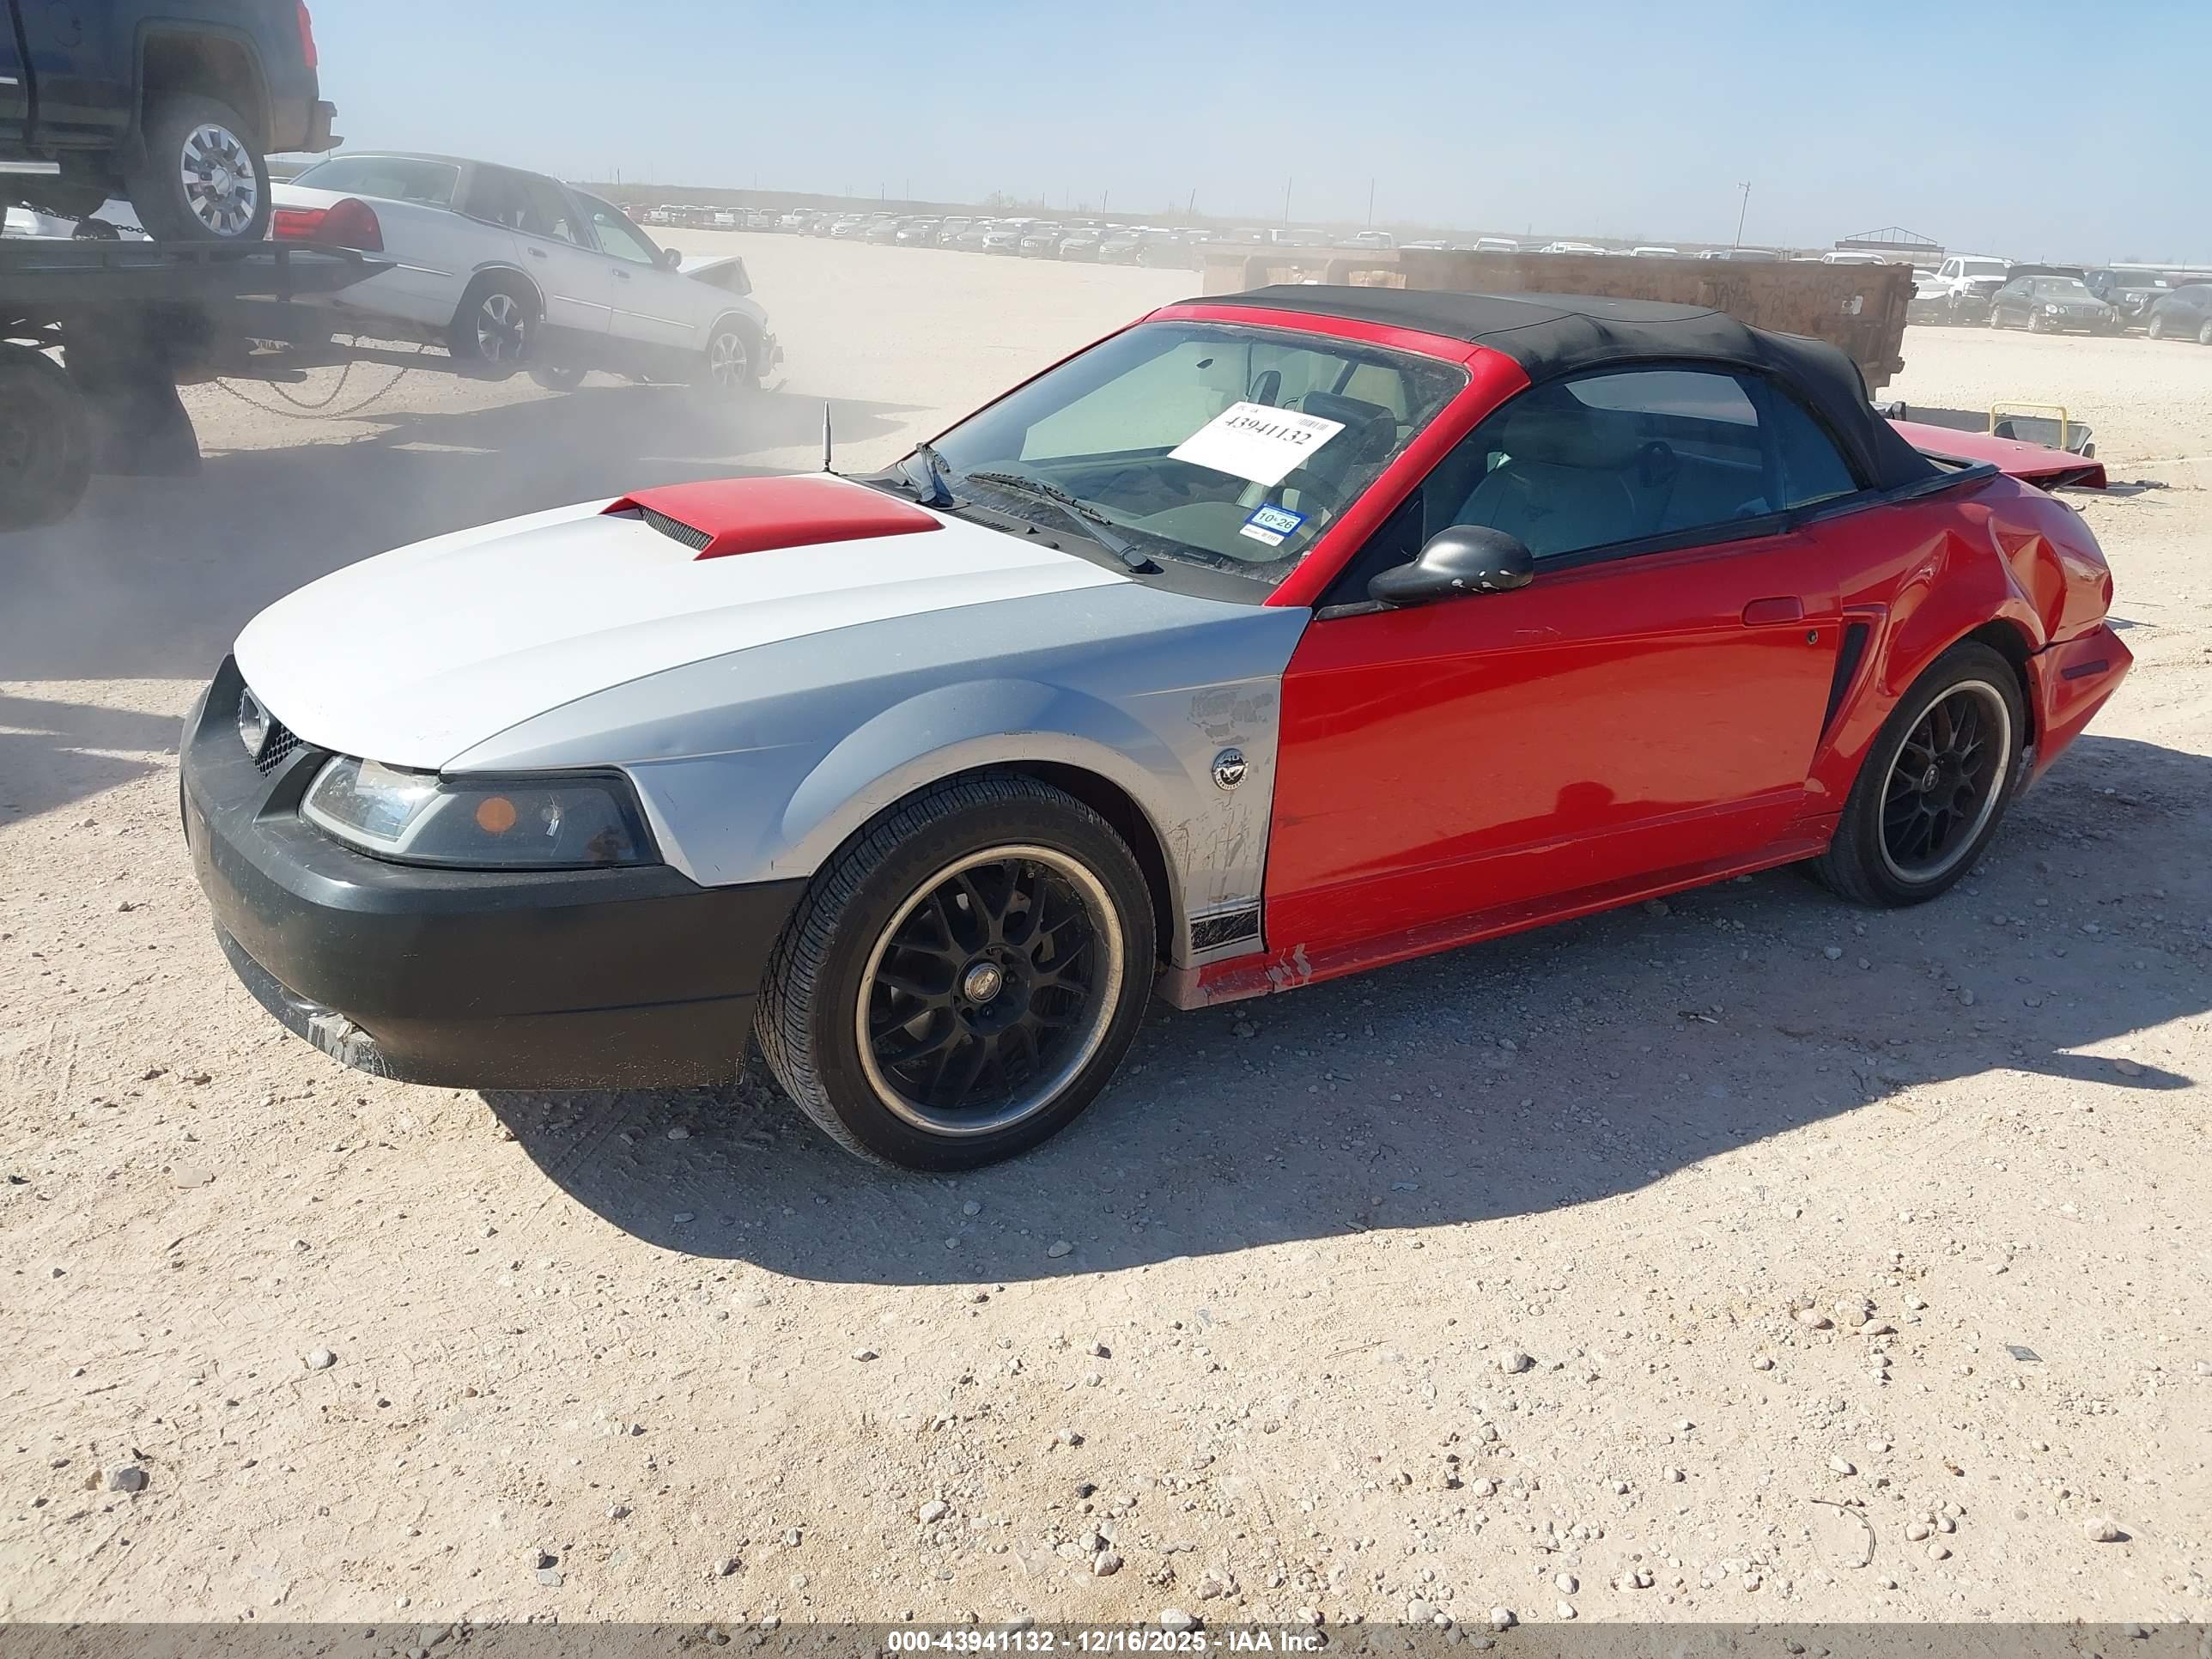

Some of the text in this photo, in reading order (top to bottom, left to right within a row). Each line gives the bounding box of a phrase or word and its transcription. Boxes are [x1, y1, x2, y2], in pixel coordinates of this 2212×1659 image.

[1225, 416, 1312, 445] 43941132
[1259, 513, 1295, 529] 10 26
